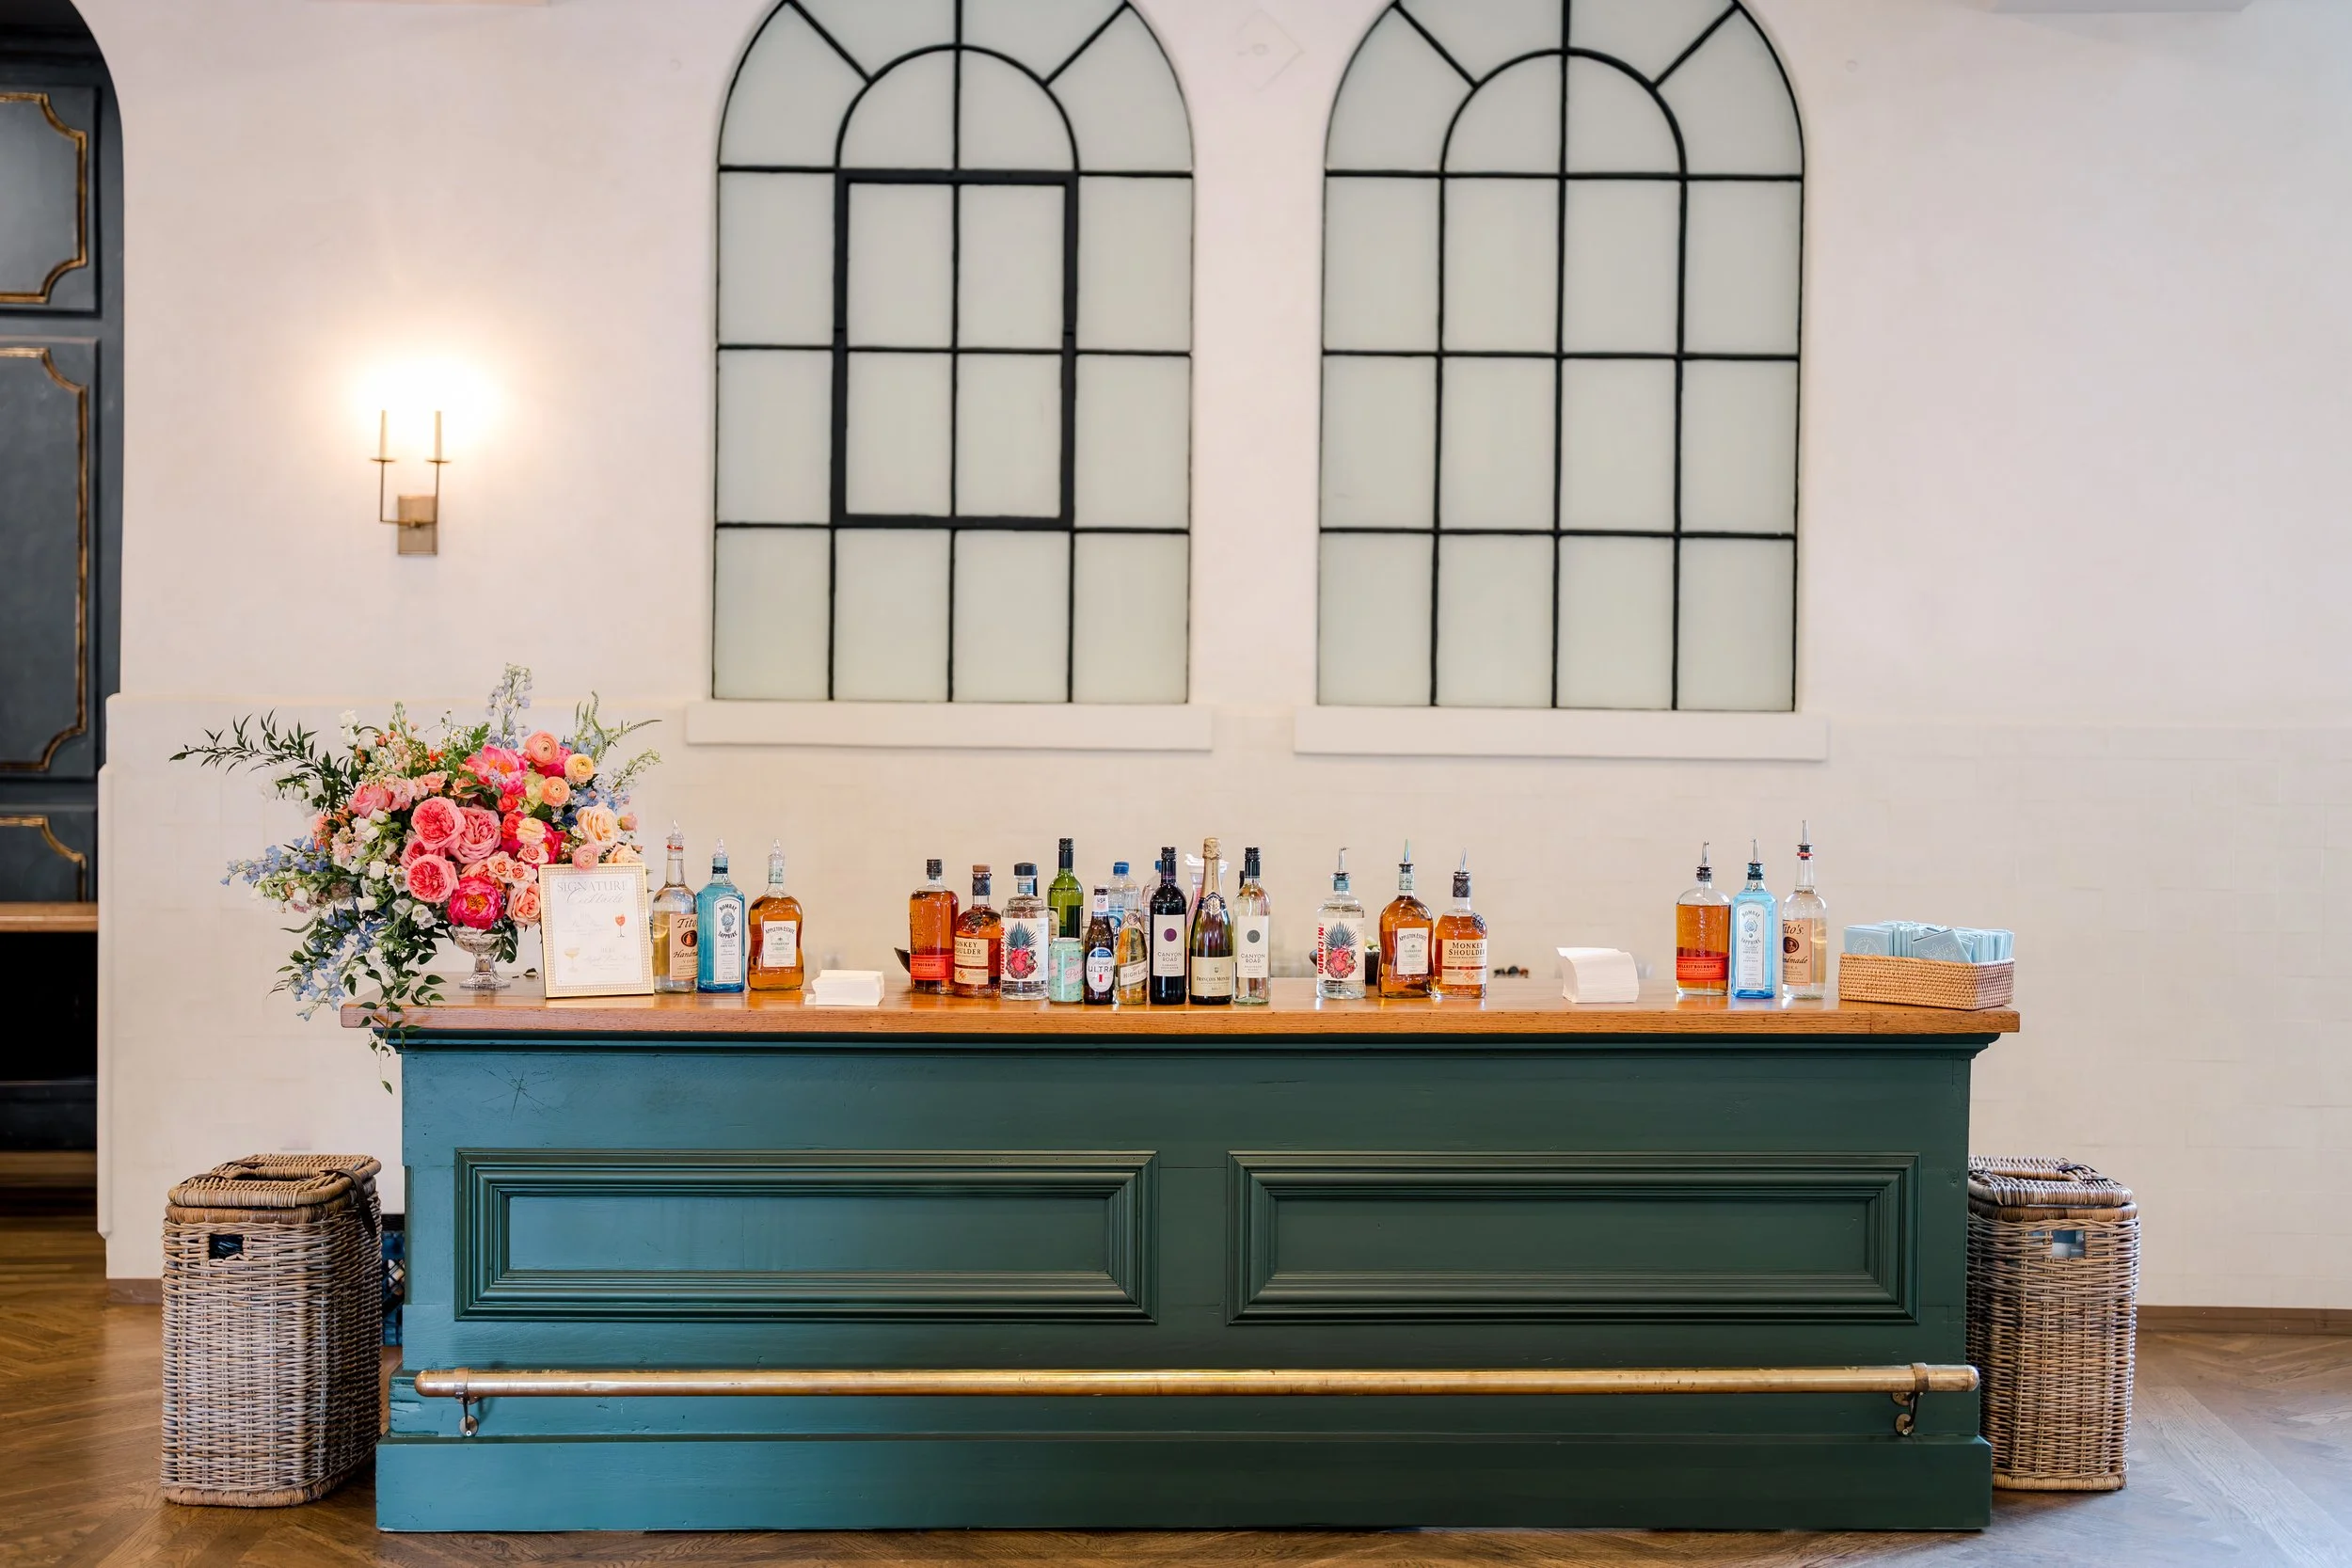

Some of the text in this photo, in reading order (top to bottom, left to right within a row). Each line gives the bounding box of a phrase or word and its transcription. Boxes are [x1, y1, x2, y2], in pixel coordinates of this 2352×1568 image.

[719, 903, 738, 911] BOMBAY
[1741, 910, 1760, 918] BOMBAY
[677, 917, 697, 928] Tito
[718, 930, 738, 939] SAPPHIRE
[1740, 937, 1761, 945] SAPPHIRE
